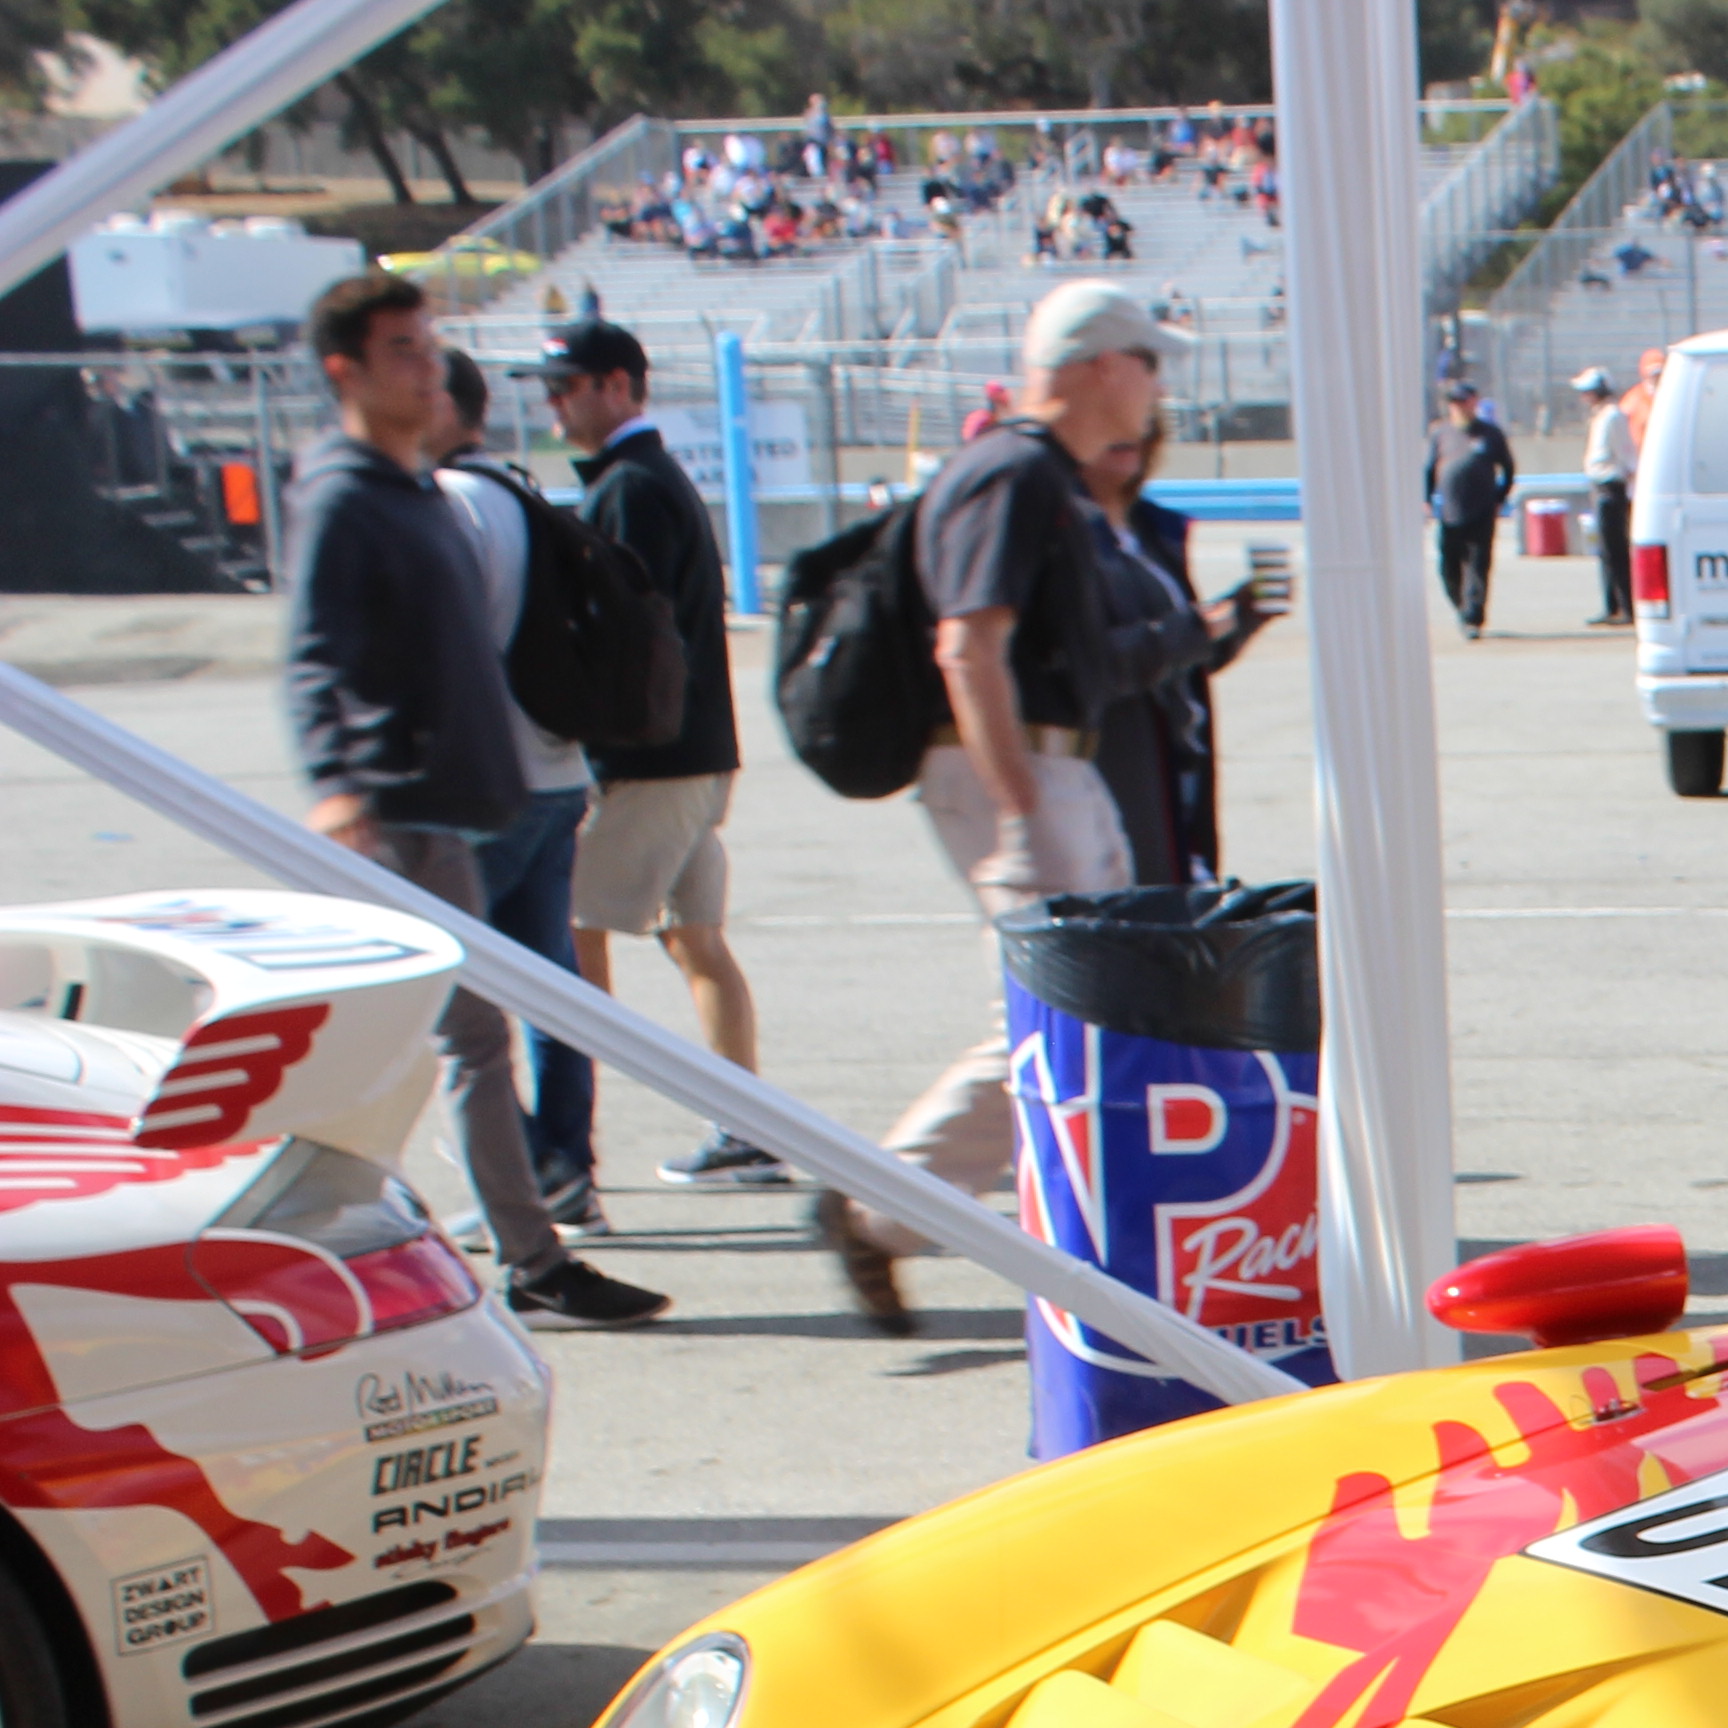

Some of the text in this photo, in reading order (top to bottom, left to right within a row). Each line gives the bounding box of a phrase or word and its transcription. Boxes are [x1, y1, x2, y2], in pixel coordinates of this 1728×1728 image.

[1214, 1316, 1327, 1350] UELS
[371, 1433, 483, 1496] CIRCLE
[124, 1588, 206, 1624] DESIGN
[125, 1611, 208, 1645] GROUP
